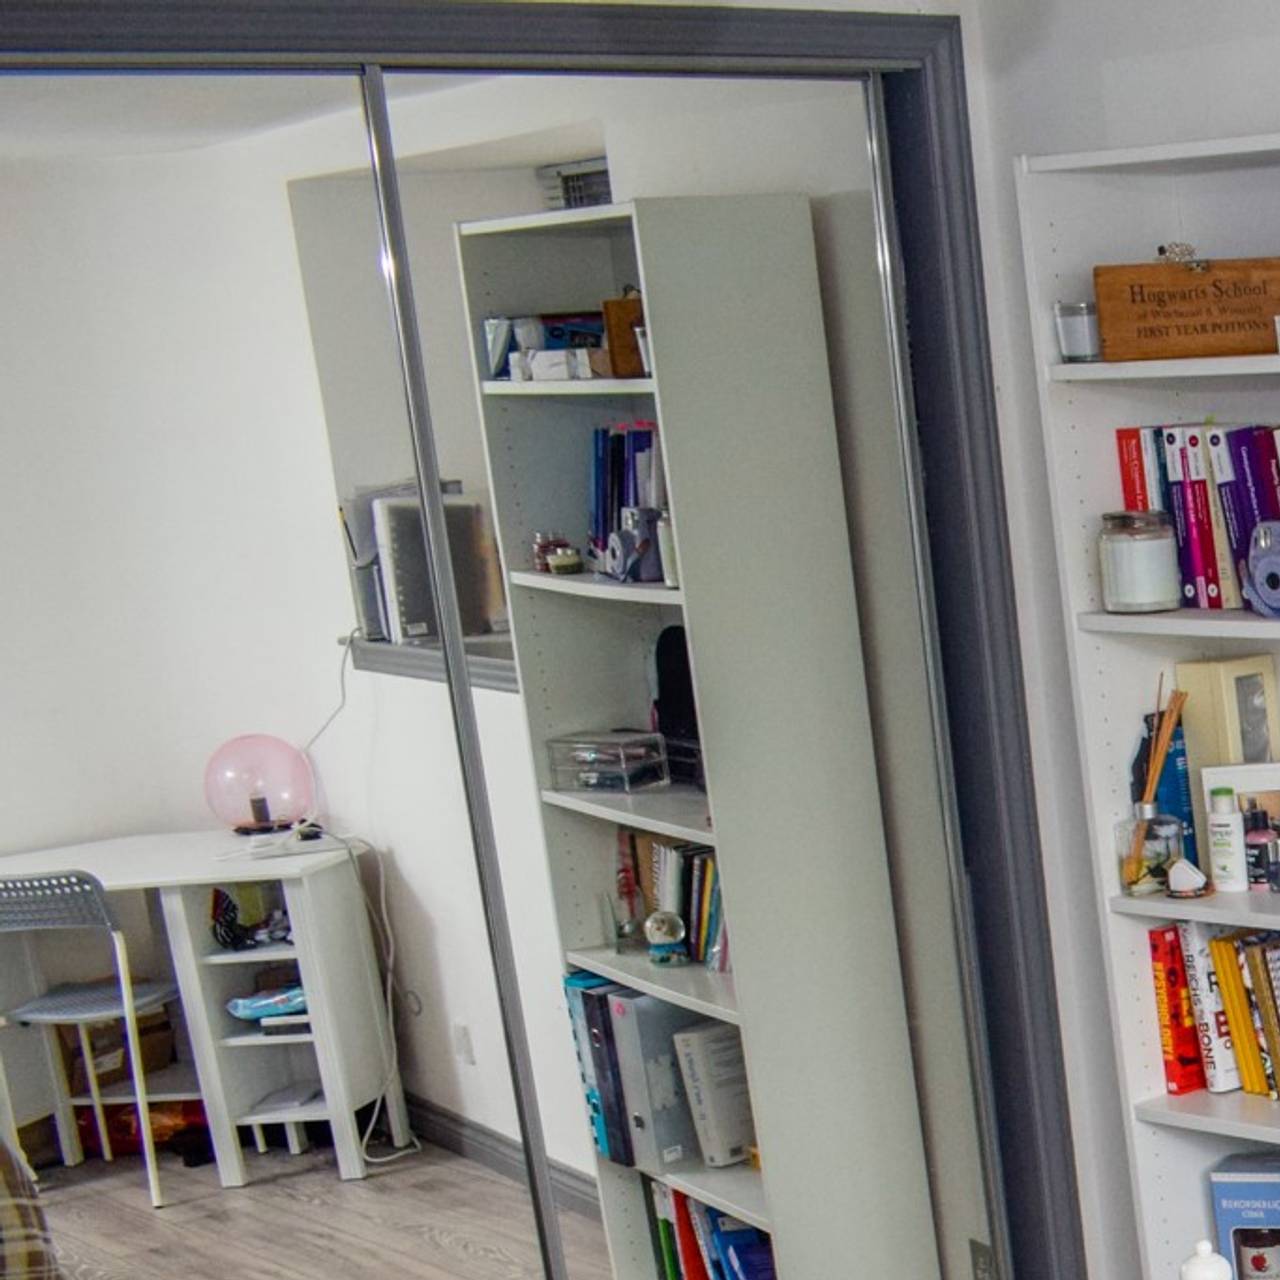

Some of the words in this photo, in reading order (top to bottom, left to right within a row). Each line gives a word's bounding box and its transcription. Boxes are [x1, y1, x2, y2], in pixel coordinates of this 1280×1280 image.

[1129, 283, 1207, 306] Hogwarts
[1212, 279, 1268, 299] School
[1136, 325, 1171, 338] FIRST
[1175, 323, 1210, 336] YEAR
[1211, 321, 1269, 334] POTIONS
[1184, 952, 1202, 1006] REICHS
[1197, 1021, 1217, 1071] BONE
